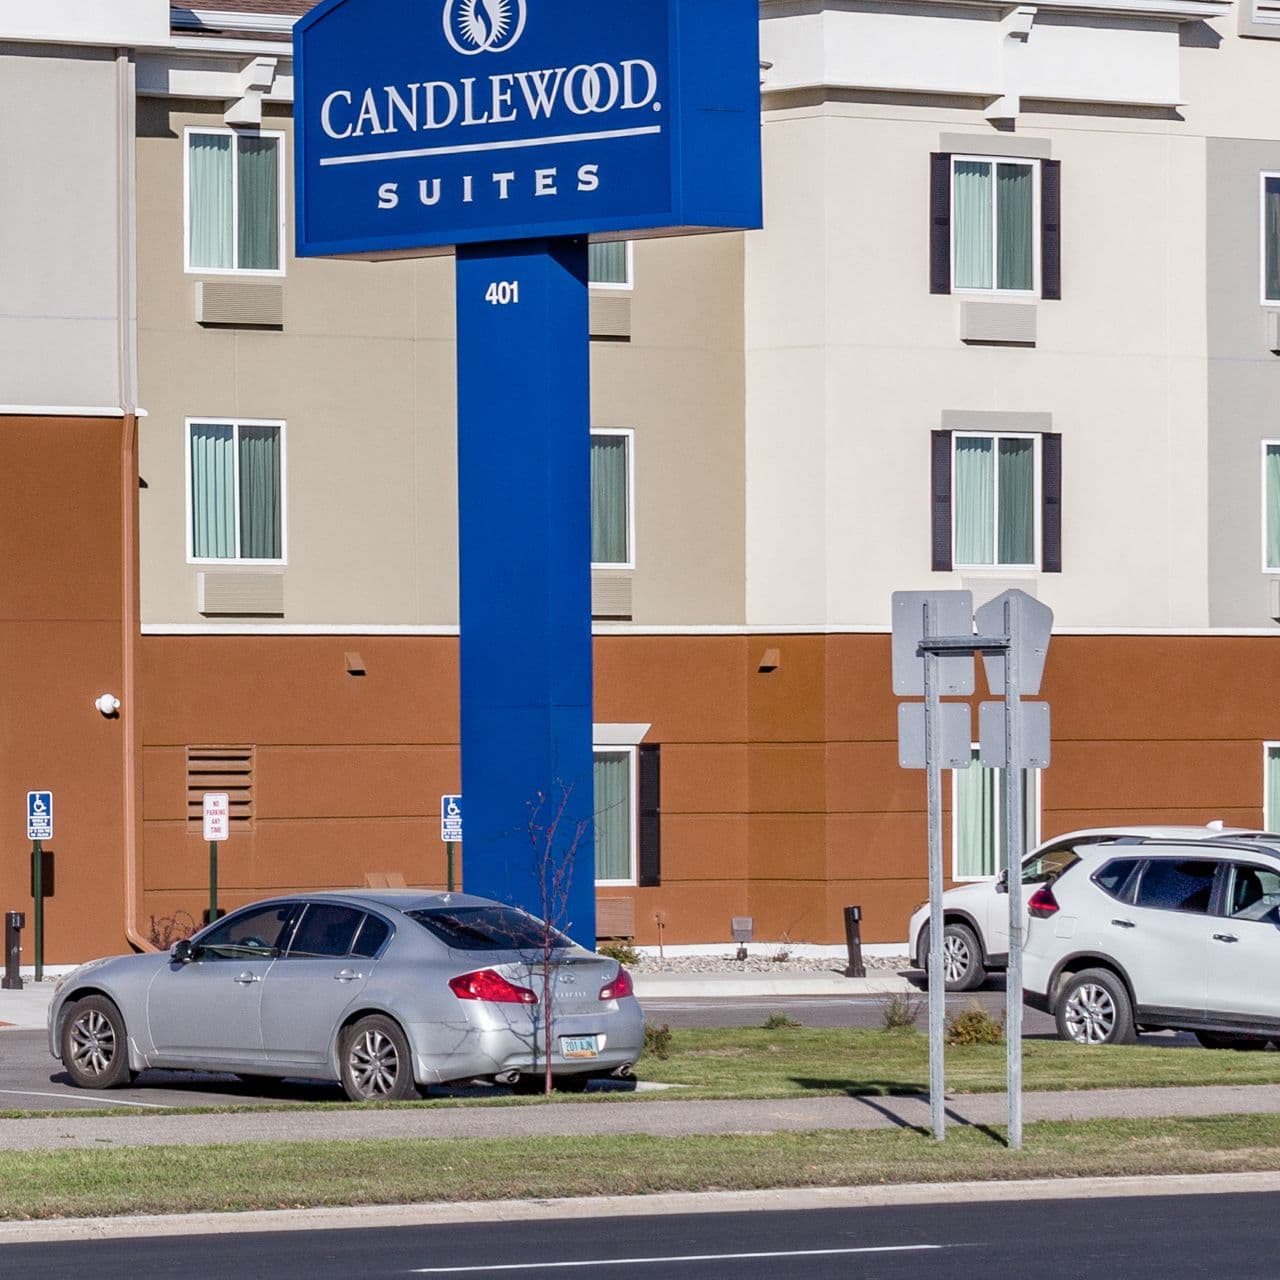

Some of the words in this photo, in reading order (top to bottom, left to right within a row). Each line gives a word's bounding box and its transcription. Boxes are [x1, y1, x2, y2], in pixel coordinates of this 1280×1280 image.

[320, 58, 658, 140] CANDLEWOOD
[377, 164, 600, 210] SUITES
[485, 280, 519, 305] 401
